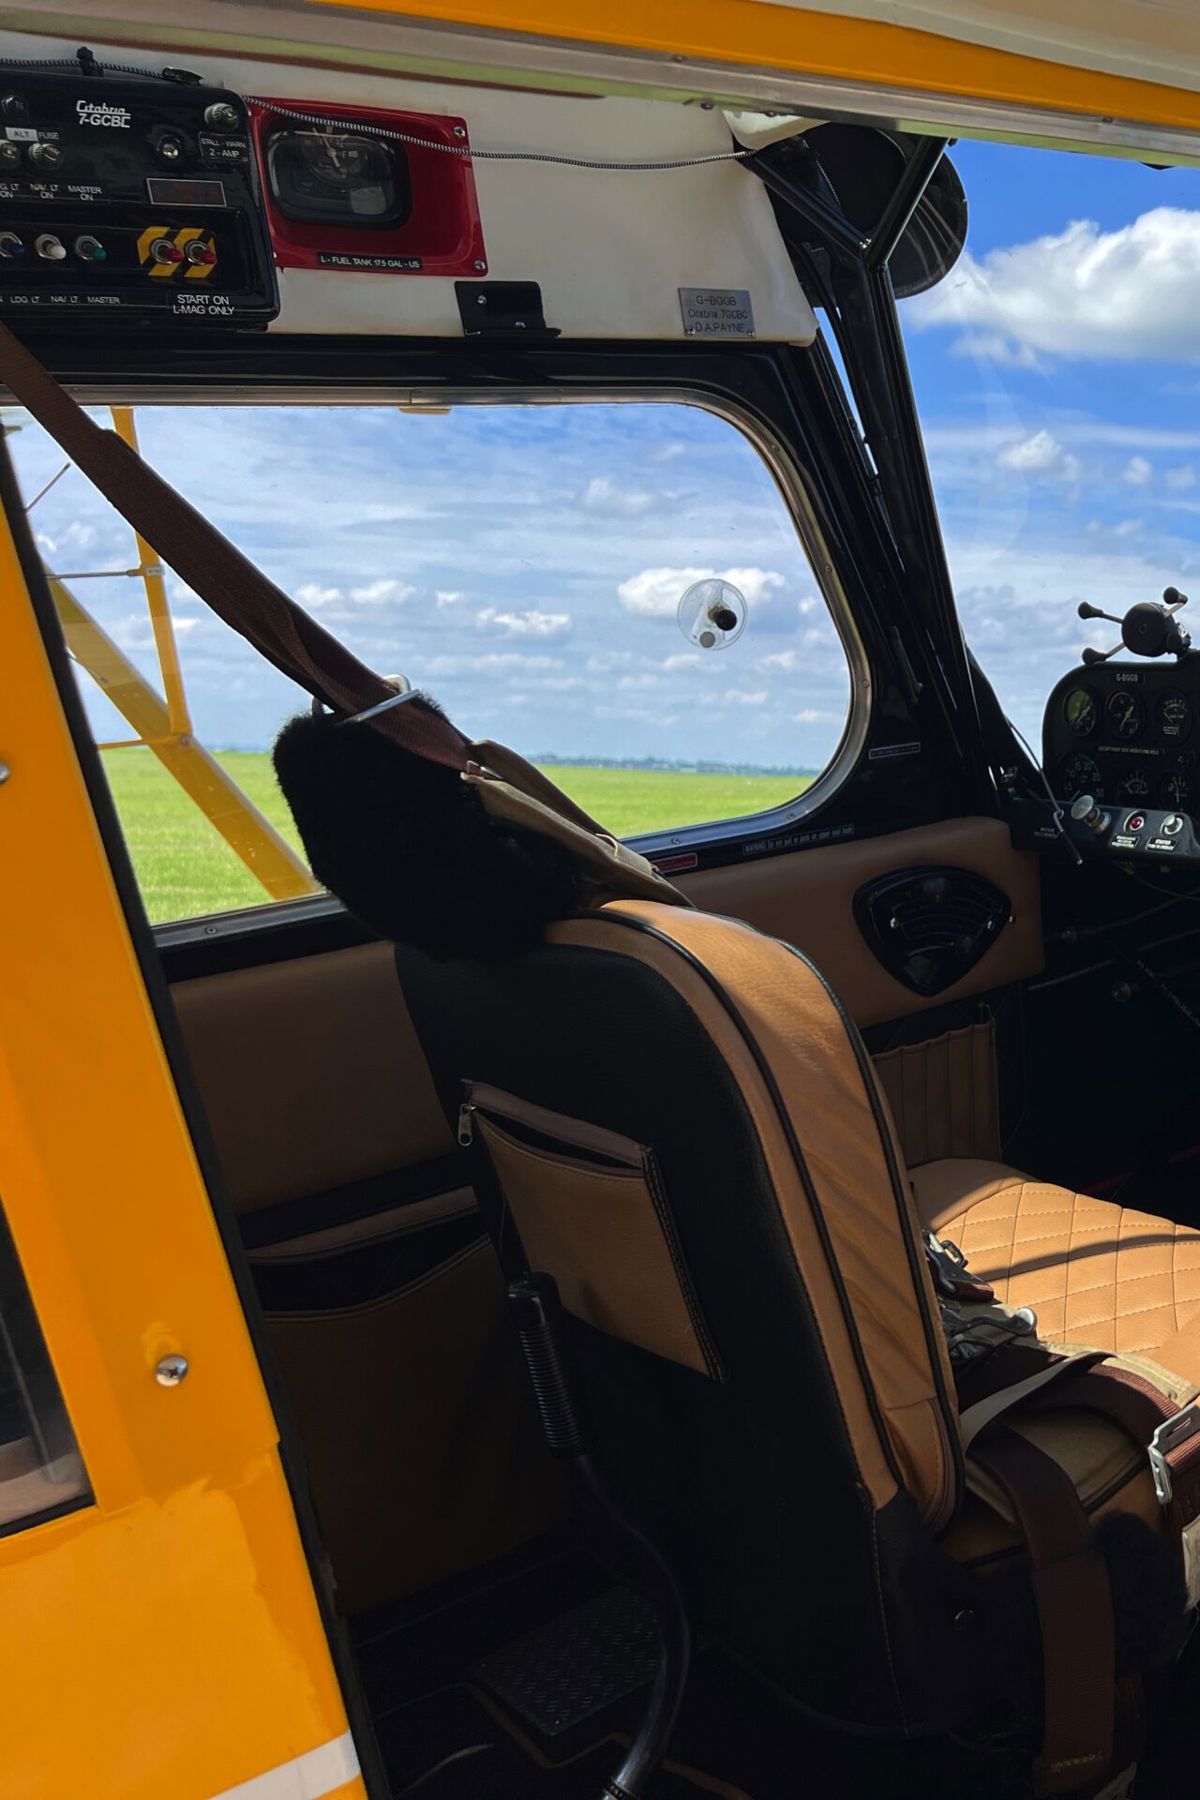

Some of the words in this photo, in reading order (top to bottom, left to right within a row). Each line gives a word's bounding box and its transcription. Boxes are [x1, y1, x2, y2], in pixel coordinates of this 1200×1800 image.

[76, 100, 131, 116] Citabria
[14, 129, 29, 137] ALT
[38, 132, 60, 140] FUSE
[67, 184, 103, 194] MASTER
[40, 191, 54, 199] ON
[80, 193, 94, 201] ON
[332, 256, 351, 265] FUEL
[352, 258, 372, 266] TANK
[387, 260, 403, 268] GAL
[87, 296, 120, 304] MASTER
[177, 294, 210, 305] START
[213, 295, 230, 306] ON
[172, 304, 205, 315] L-MAG
[208, 306, 235, 316] ONLY
